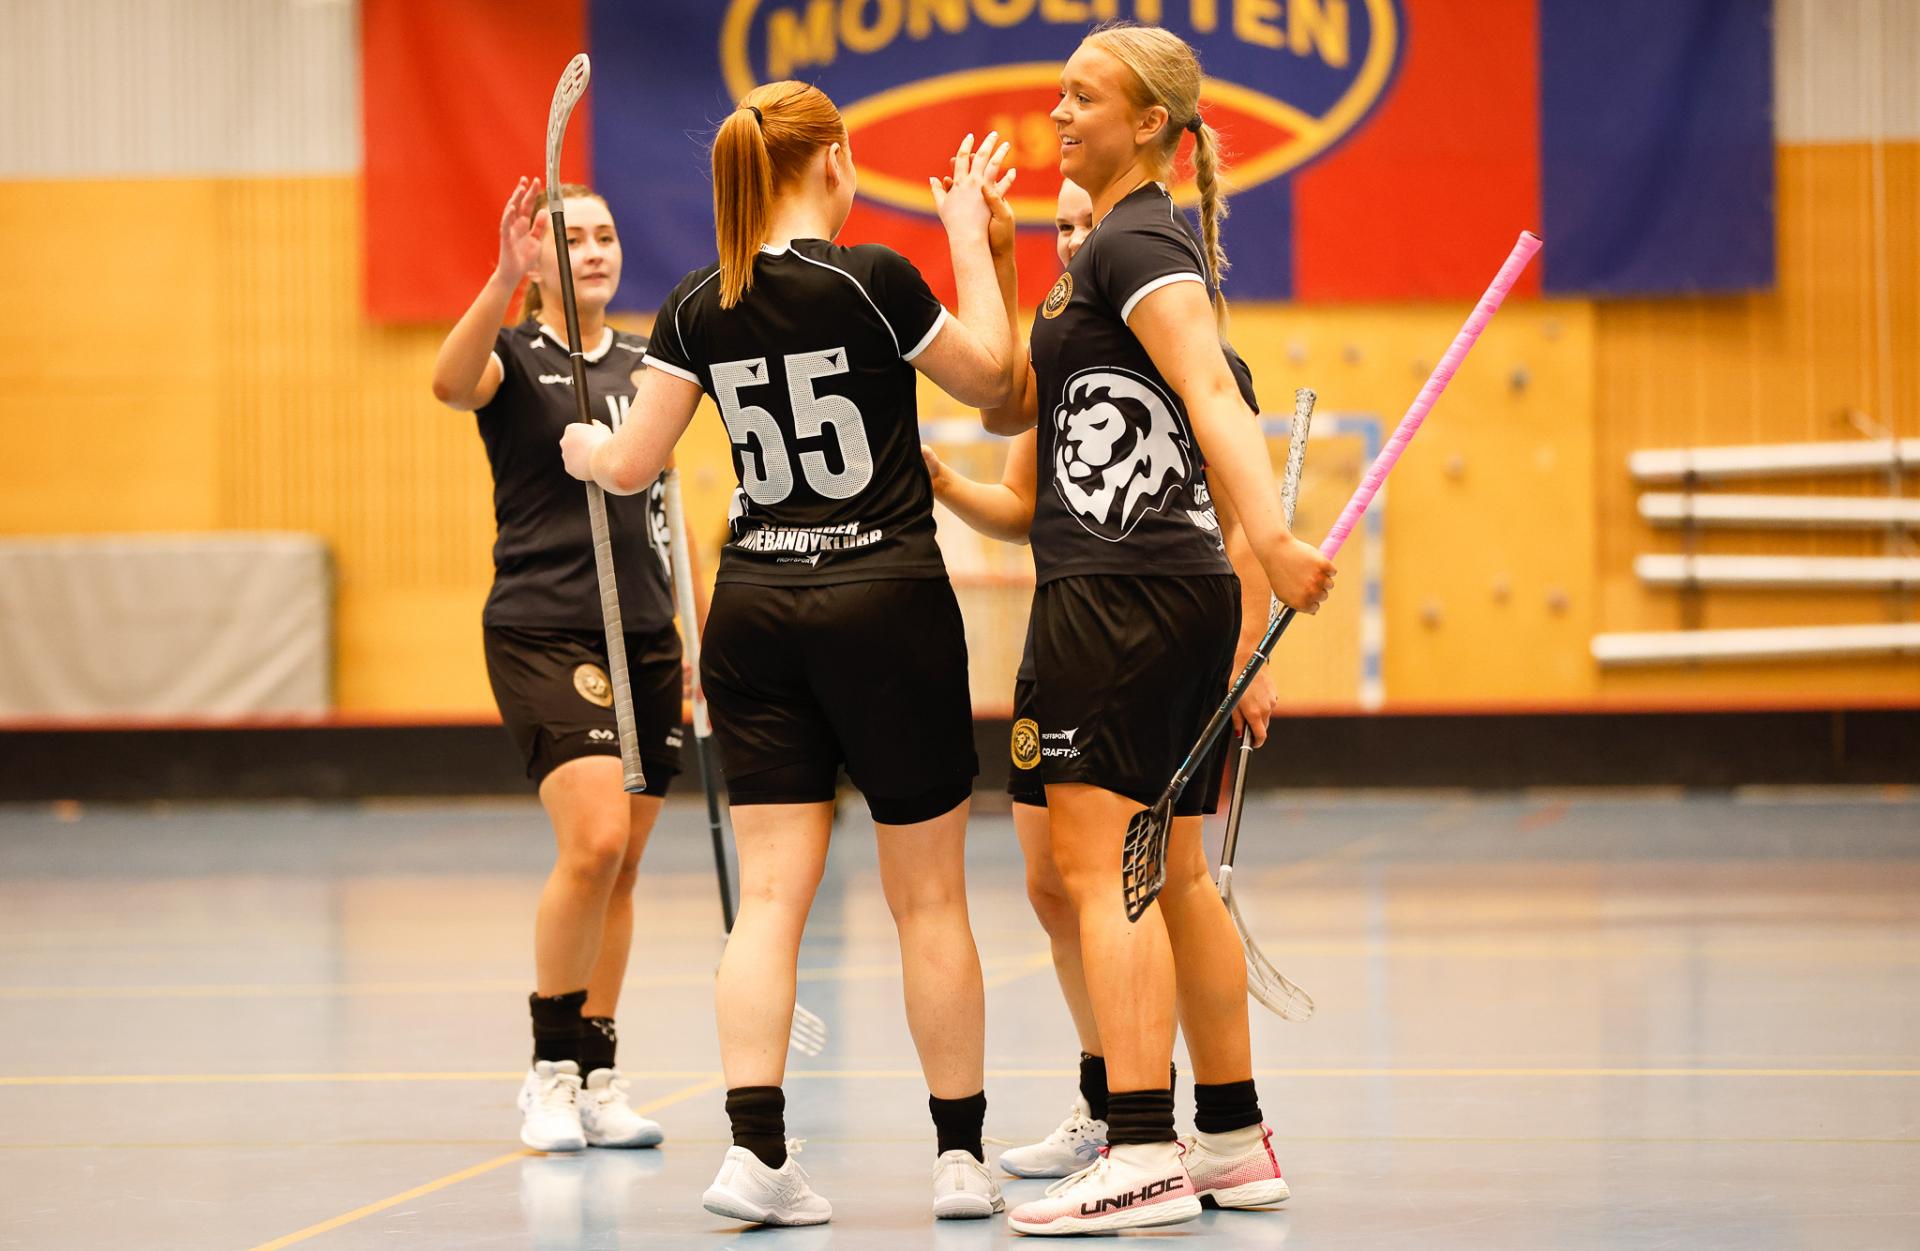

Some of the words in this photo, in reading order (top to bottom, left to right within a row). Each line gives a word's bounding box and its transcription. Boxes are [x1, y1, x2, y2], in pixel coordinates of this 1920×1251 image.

[709, 346, 874, 505] 55
[1042, 747, 1071, 757] CRAFT
[1080, 1175, 1183, 1216] UNIHOC
